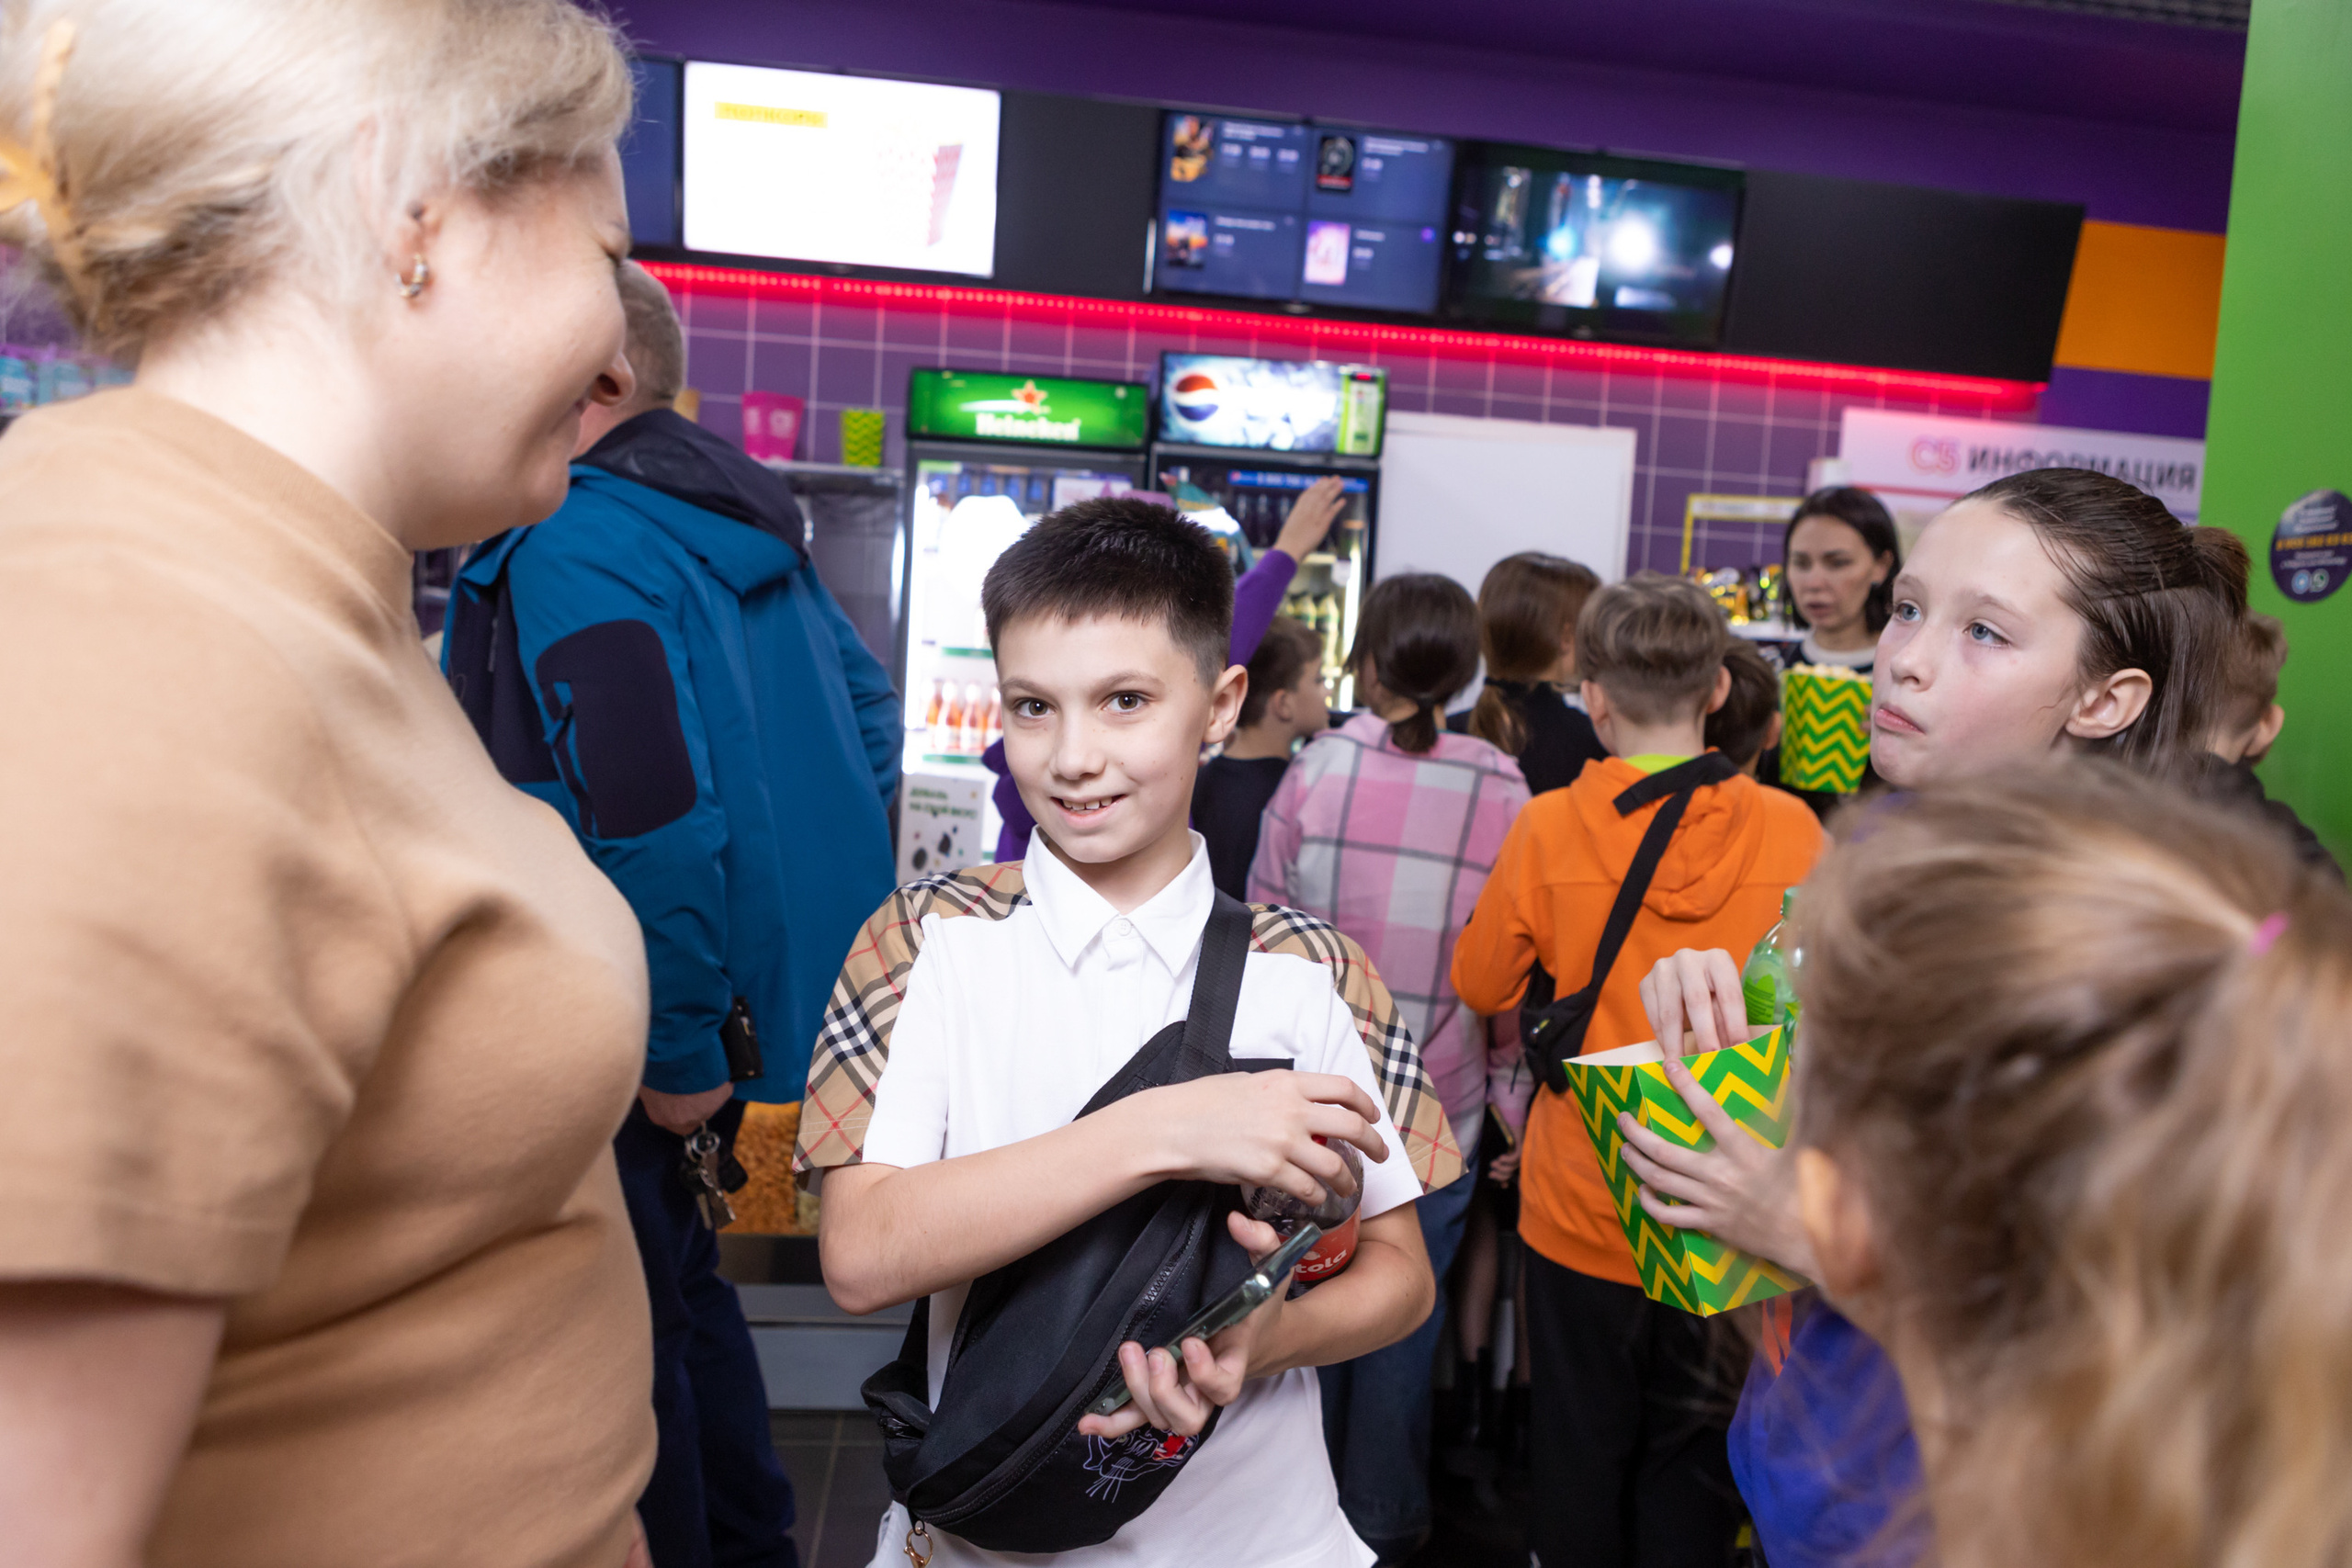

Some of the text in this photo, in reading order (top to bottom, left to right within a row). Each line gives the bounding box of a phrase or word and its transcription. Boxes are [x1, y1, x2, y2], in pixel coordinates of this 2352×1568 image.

[975, 412, 1080, 441] Heineken
[1968, 446, 2197, 493] ИНФОРМАЦИЯ
[1293, 1249, 1347, 1273] tola
